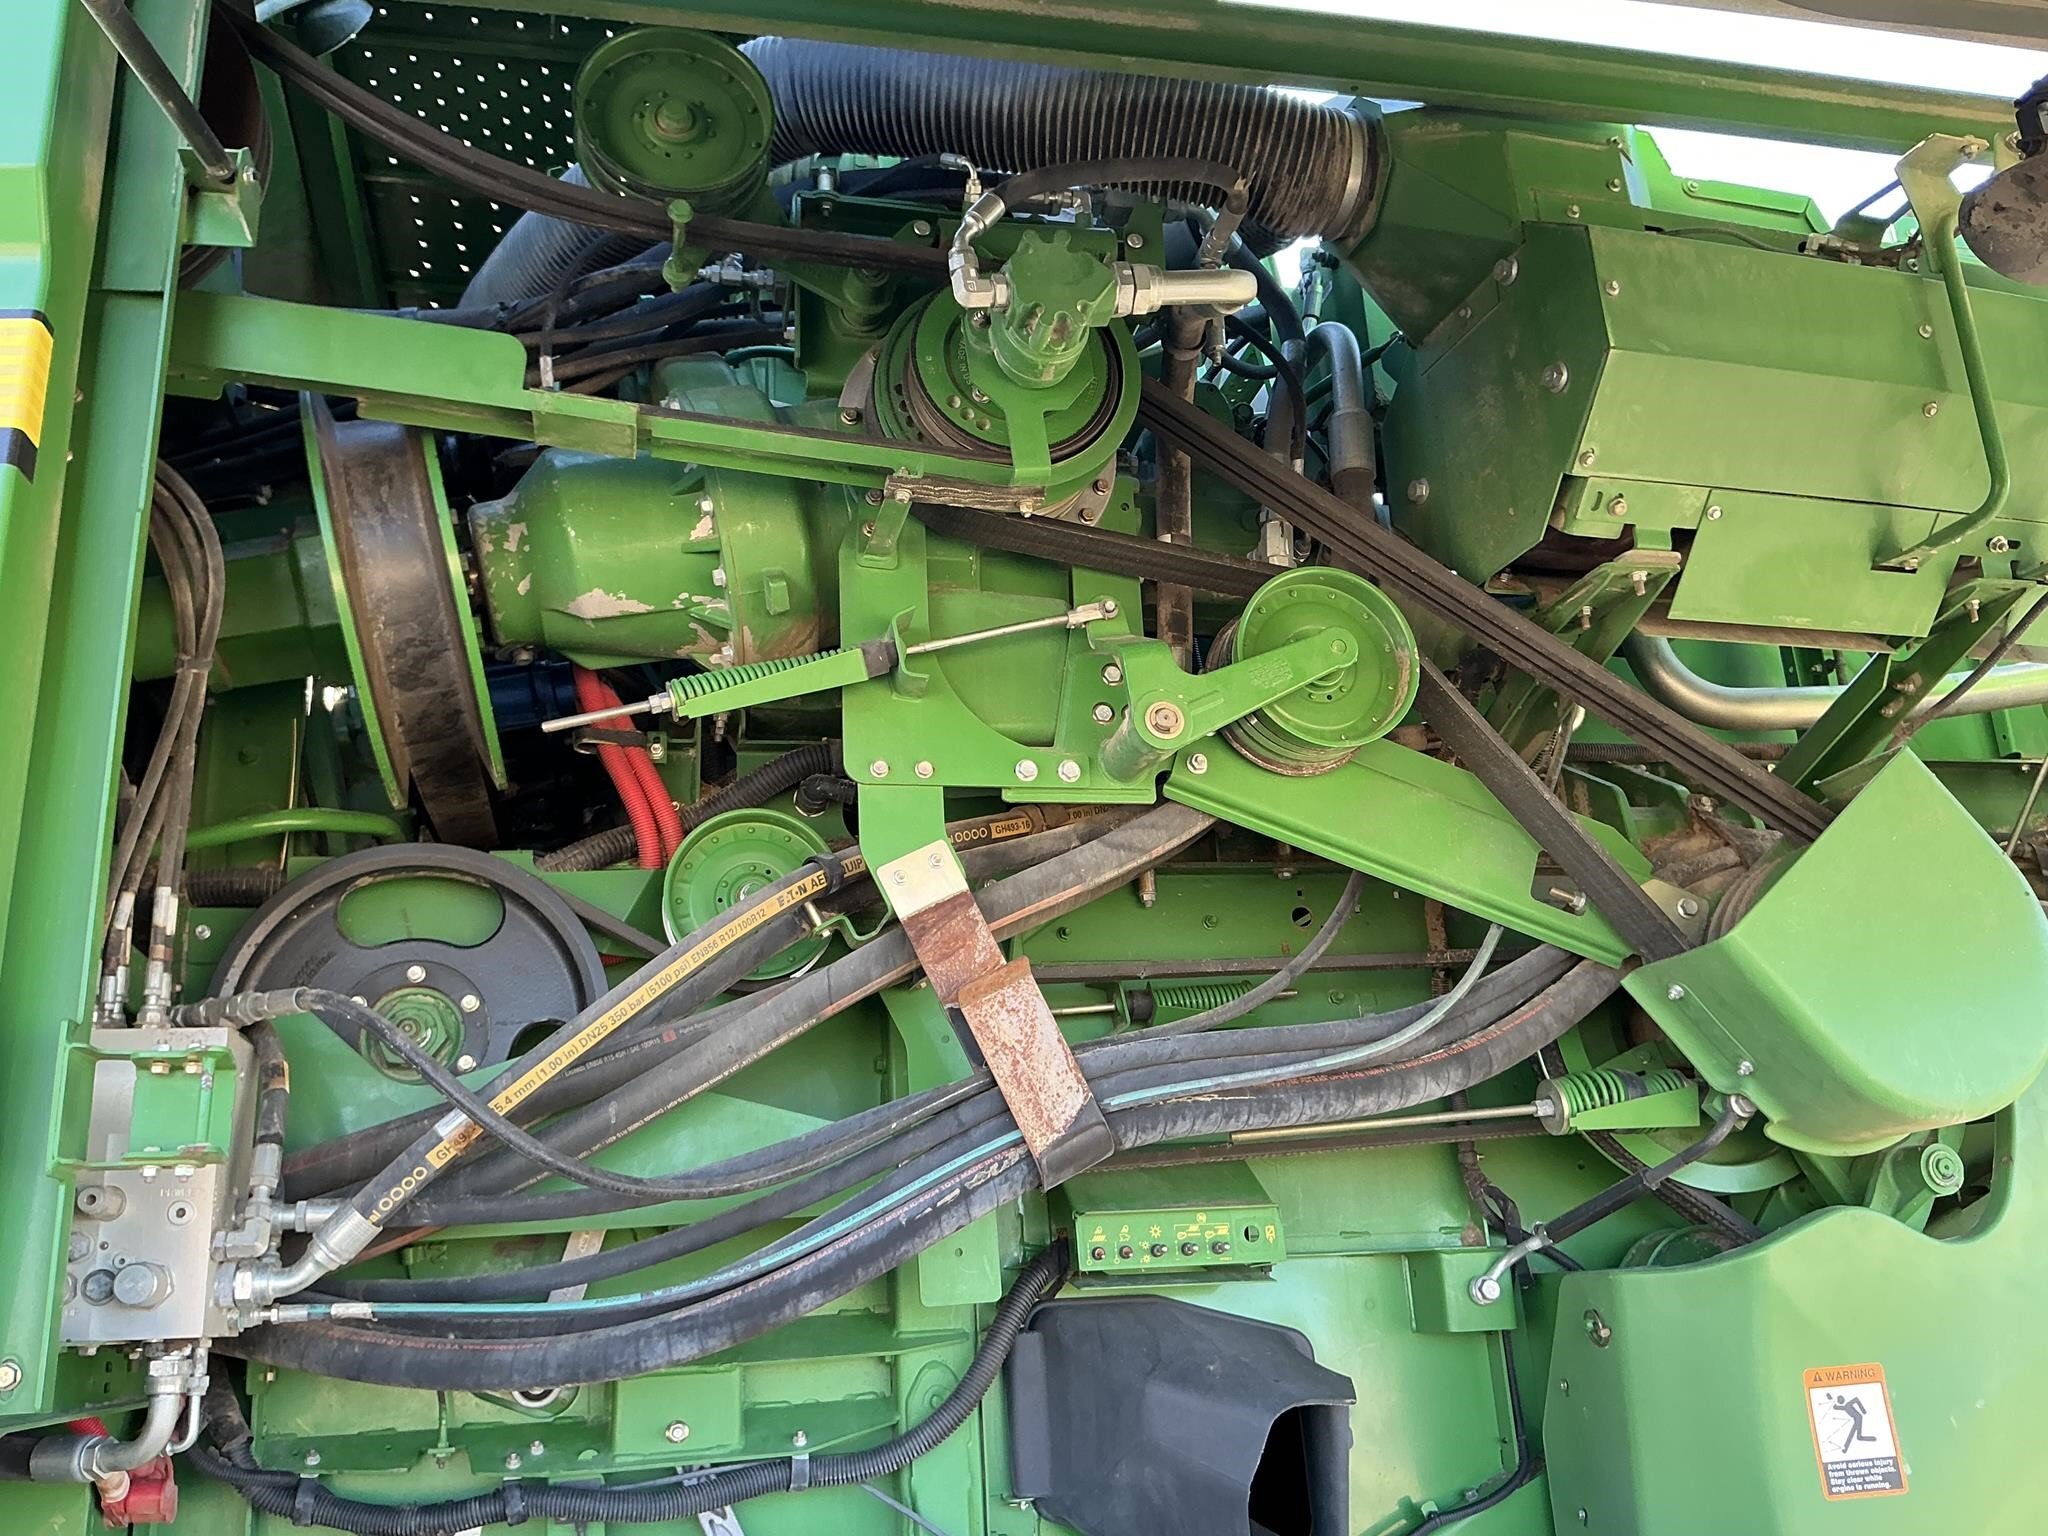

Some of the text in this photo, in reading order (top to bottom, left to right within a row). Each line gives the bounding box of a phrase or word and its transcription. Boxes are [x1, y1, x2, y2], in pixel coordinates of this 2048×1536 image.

[493, 1094, 513, 1113] 5.4
[513, 1078, 537, 1099] mm
[535, 1056, 563, 1082] (1.00
[563, 1044, 580, 1060] in)
[578, 1023, 609, 1048] DN25
[608, 1008, 629, 1027] 350
[629, 993, 646, 1011] bar
[646, 973, 673, 998] (5100
[674, 959, 691, 979] psi)
[691, 940, 719, 963] EN856
[719, 907, 768, 943] R12/100R12
[1825, 1368, 1876, 1381] WARNING
[1828, 1458, 1894, 1470] Avoid serious injury
[1828, 1466, 1897, 1478] from thrown objects.
[1830, 1474, 1883, 1487] Stay clear while
[1831, 1481, 1892, 1494] engine is running.
